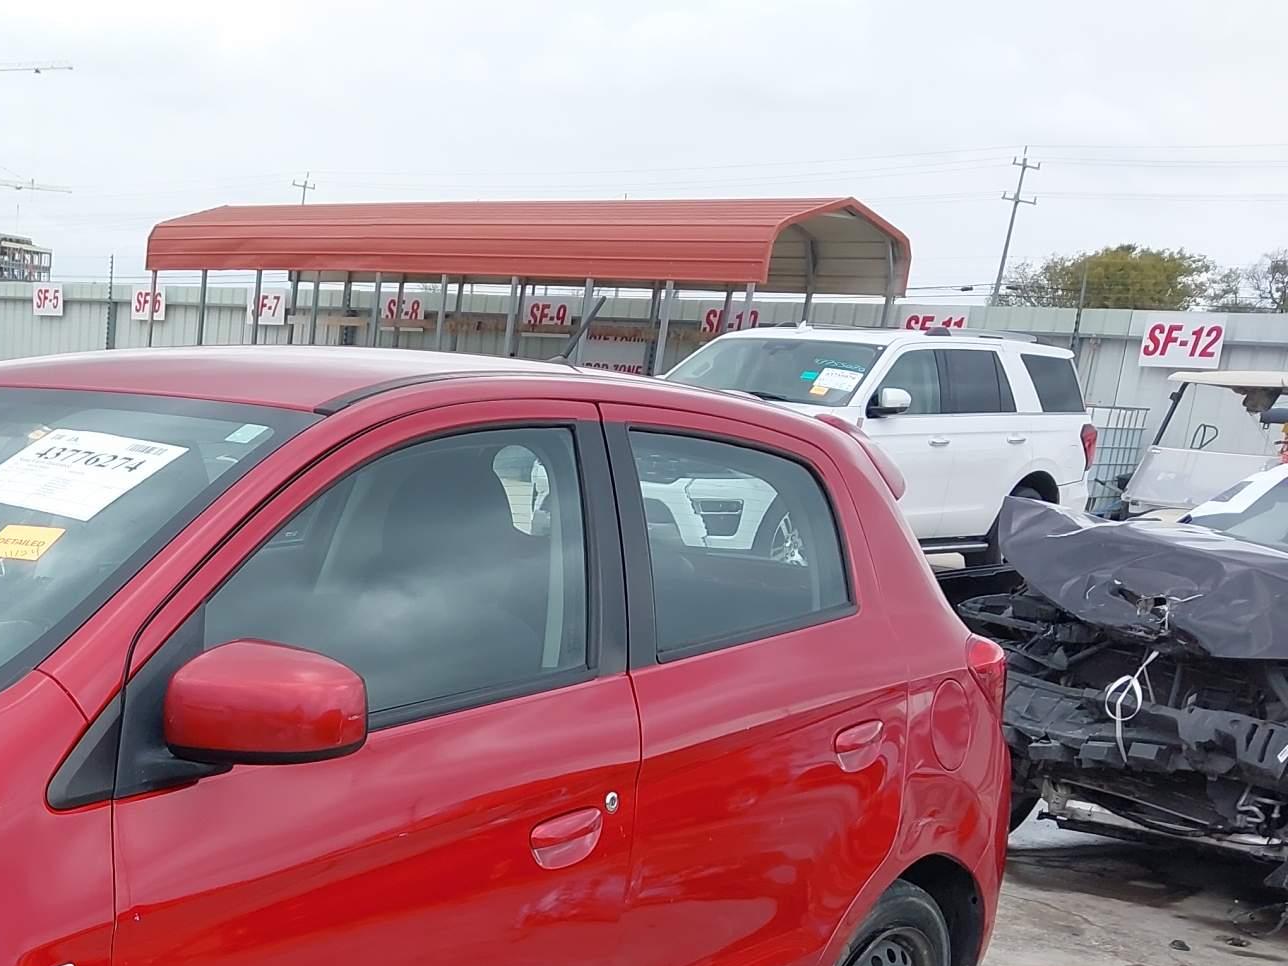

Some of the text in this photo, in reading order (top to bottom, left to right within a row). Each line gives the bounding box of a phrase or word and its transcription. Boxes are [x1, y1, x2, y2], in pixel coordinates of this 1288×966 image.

[36, 288, 60, 309] SF-5
[135, 291, 162, 313] SF6
[252, 294, 281, 317] F-7
[1142, 323, 1223, 358] SF-12
[35, 446, 147, 473] 43776274
